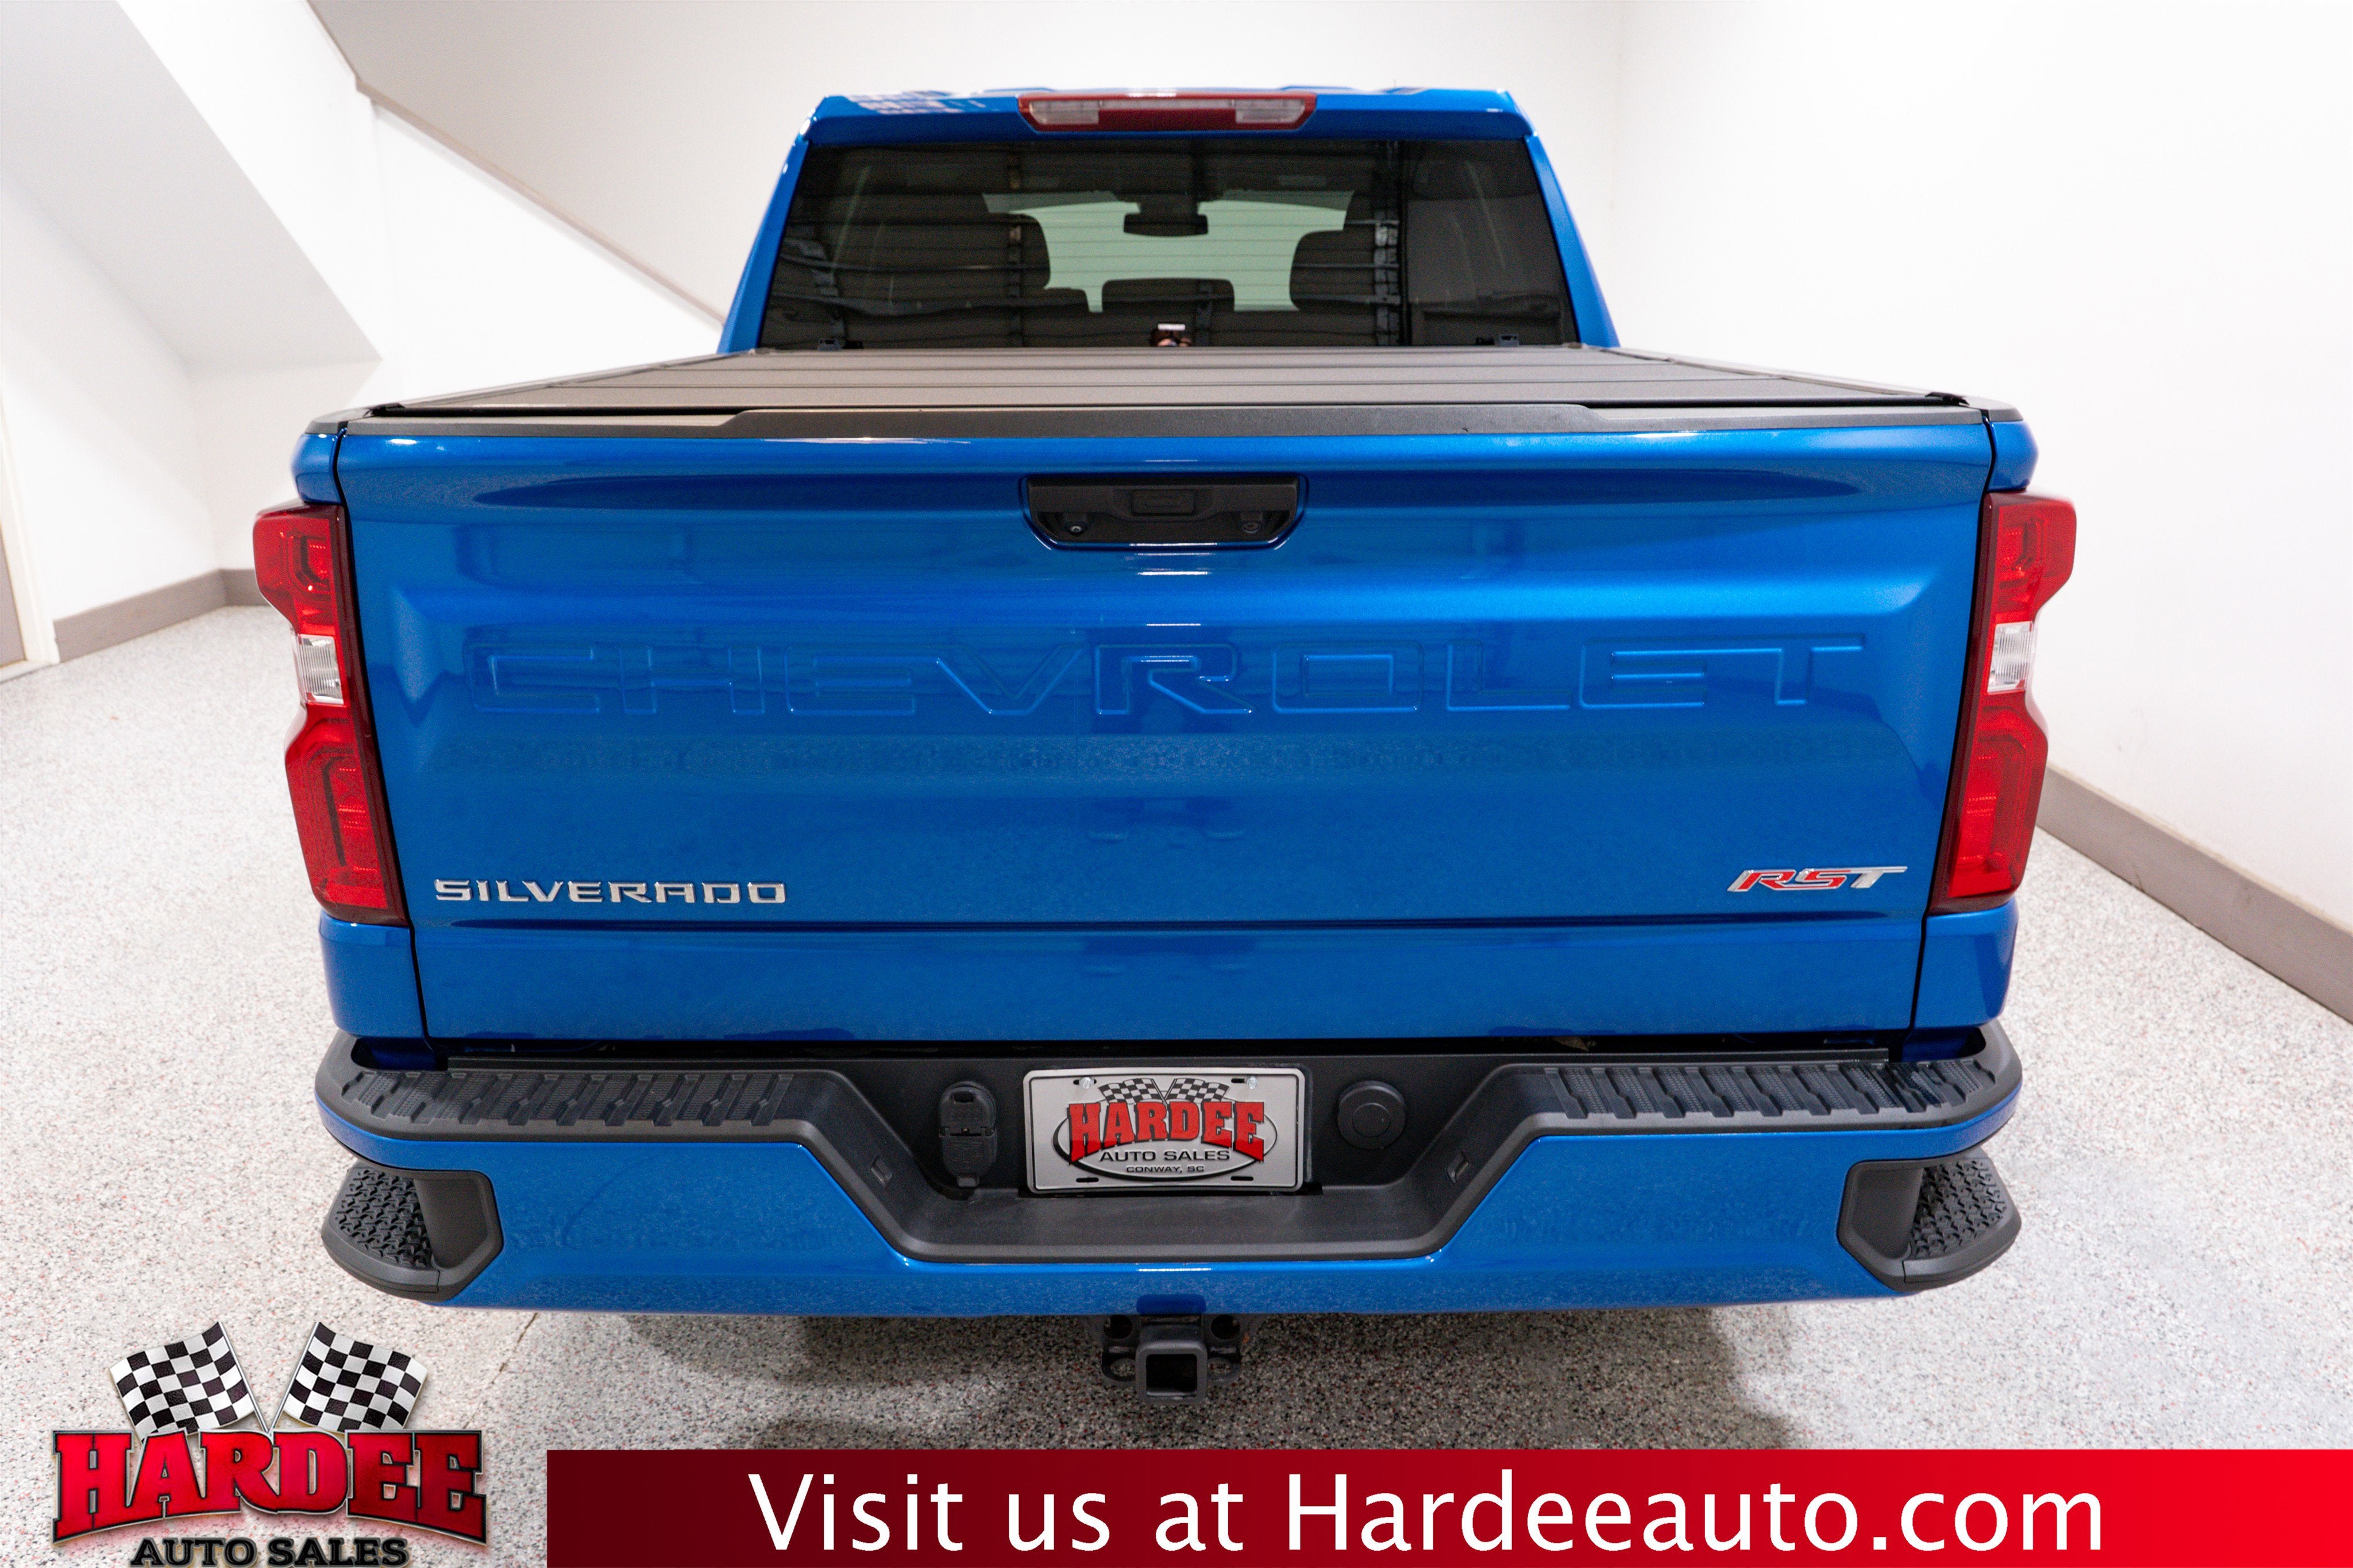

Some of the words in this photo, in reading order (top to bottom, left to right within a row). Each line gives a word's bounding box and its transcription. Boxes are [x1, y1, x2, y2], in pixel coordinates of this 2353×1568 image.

[467, 634, 1865, 715] CHEVROLET
[434, 879, 786, 903] SILVERADO
[1727, 866, 1908, 892] RST
[1067, 1101, 1264, 1164] HARDEE
[1100, 1150, 1156, 1162] AUTO
[1164, 1150, 1230, 1161] SALES
